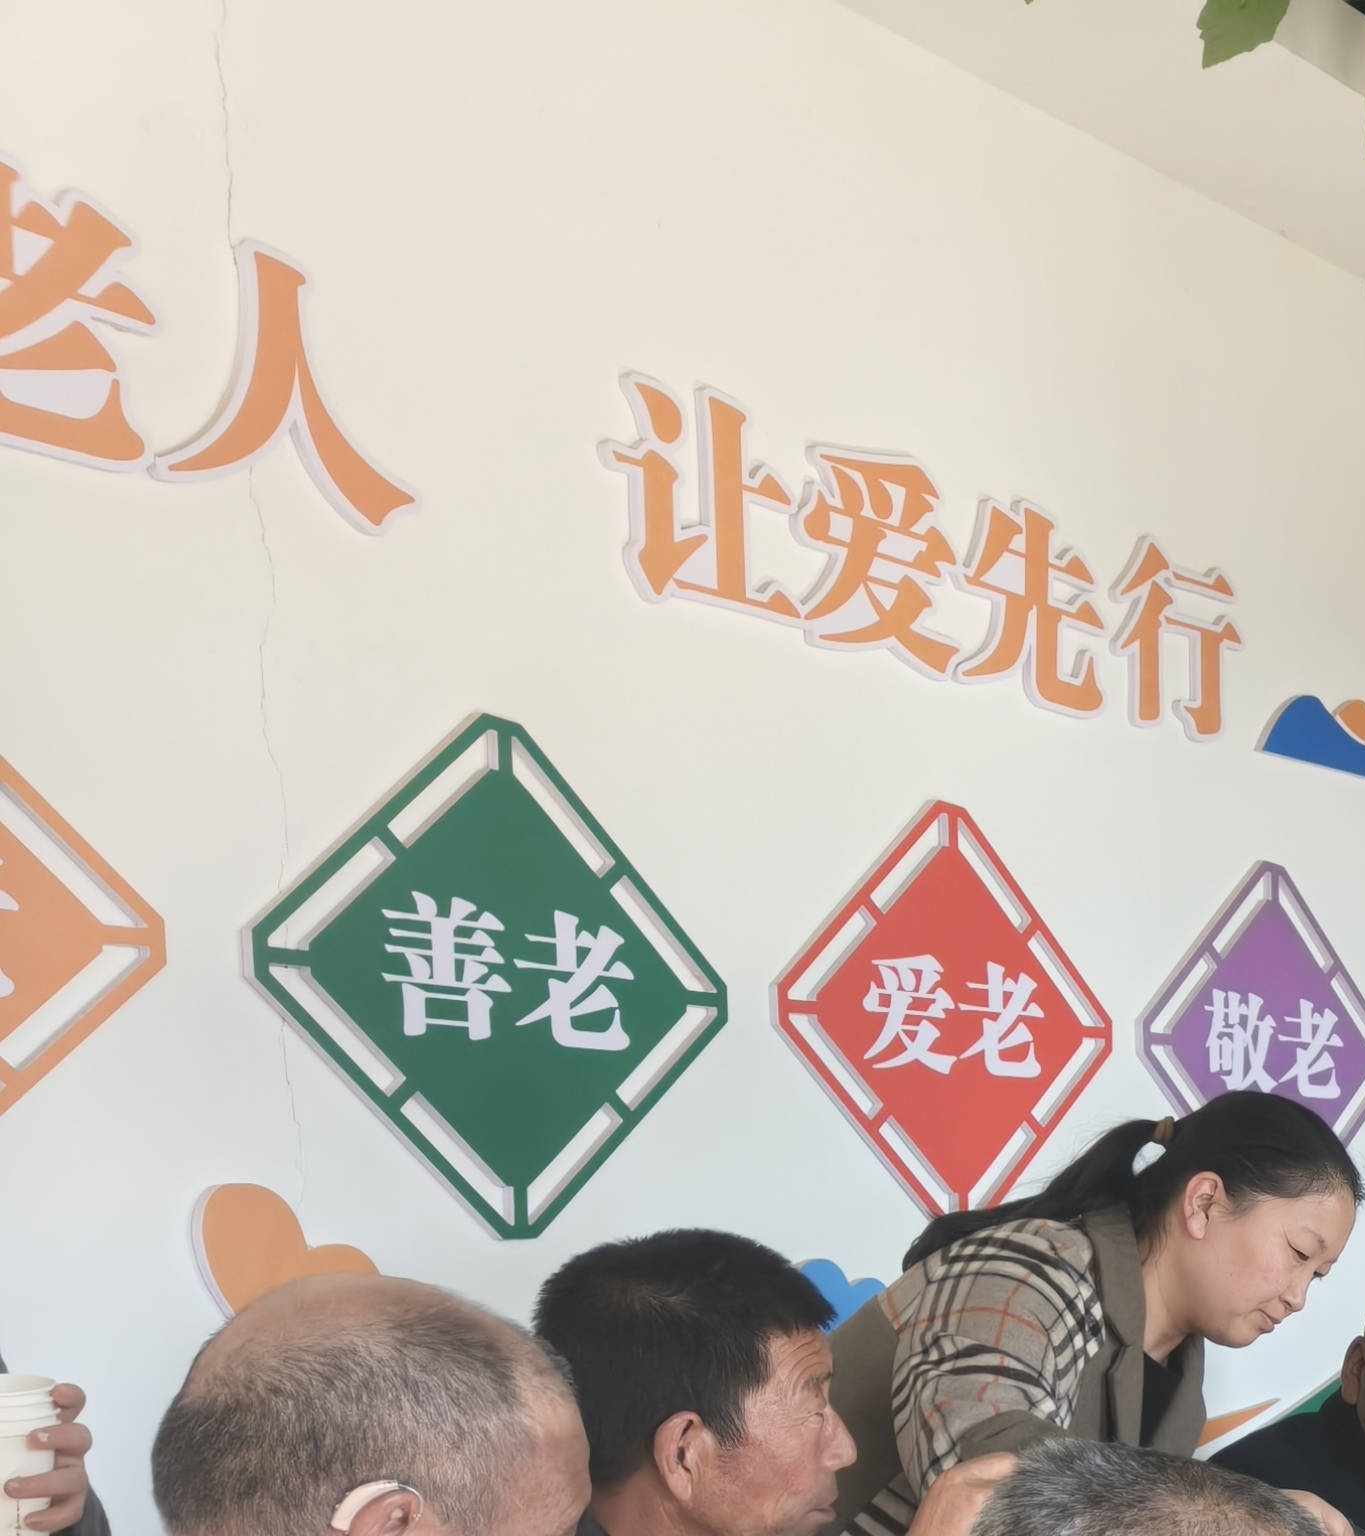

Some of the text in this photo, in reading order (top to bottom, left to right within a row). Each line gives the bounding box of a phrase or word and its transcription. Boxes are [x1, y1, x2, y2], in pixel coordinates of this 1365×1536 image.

[611, 378, 1243, 739] 让爱先行
[379, 889, 636, 1053] 善老
[861, 953, 1046, 1082] 爱老
[1203, 988, 1345, 1100] 敬老
